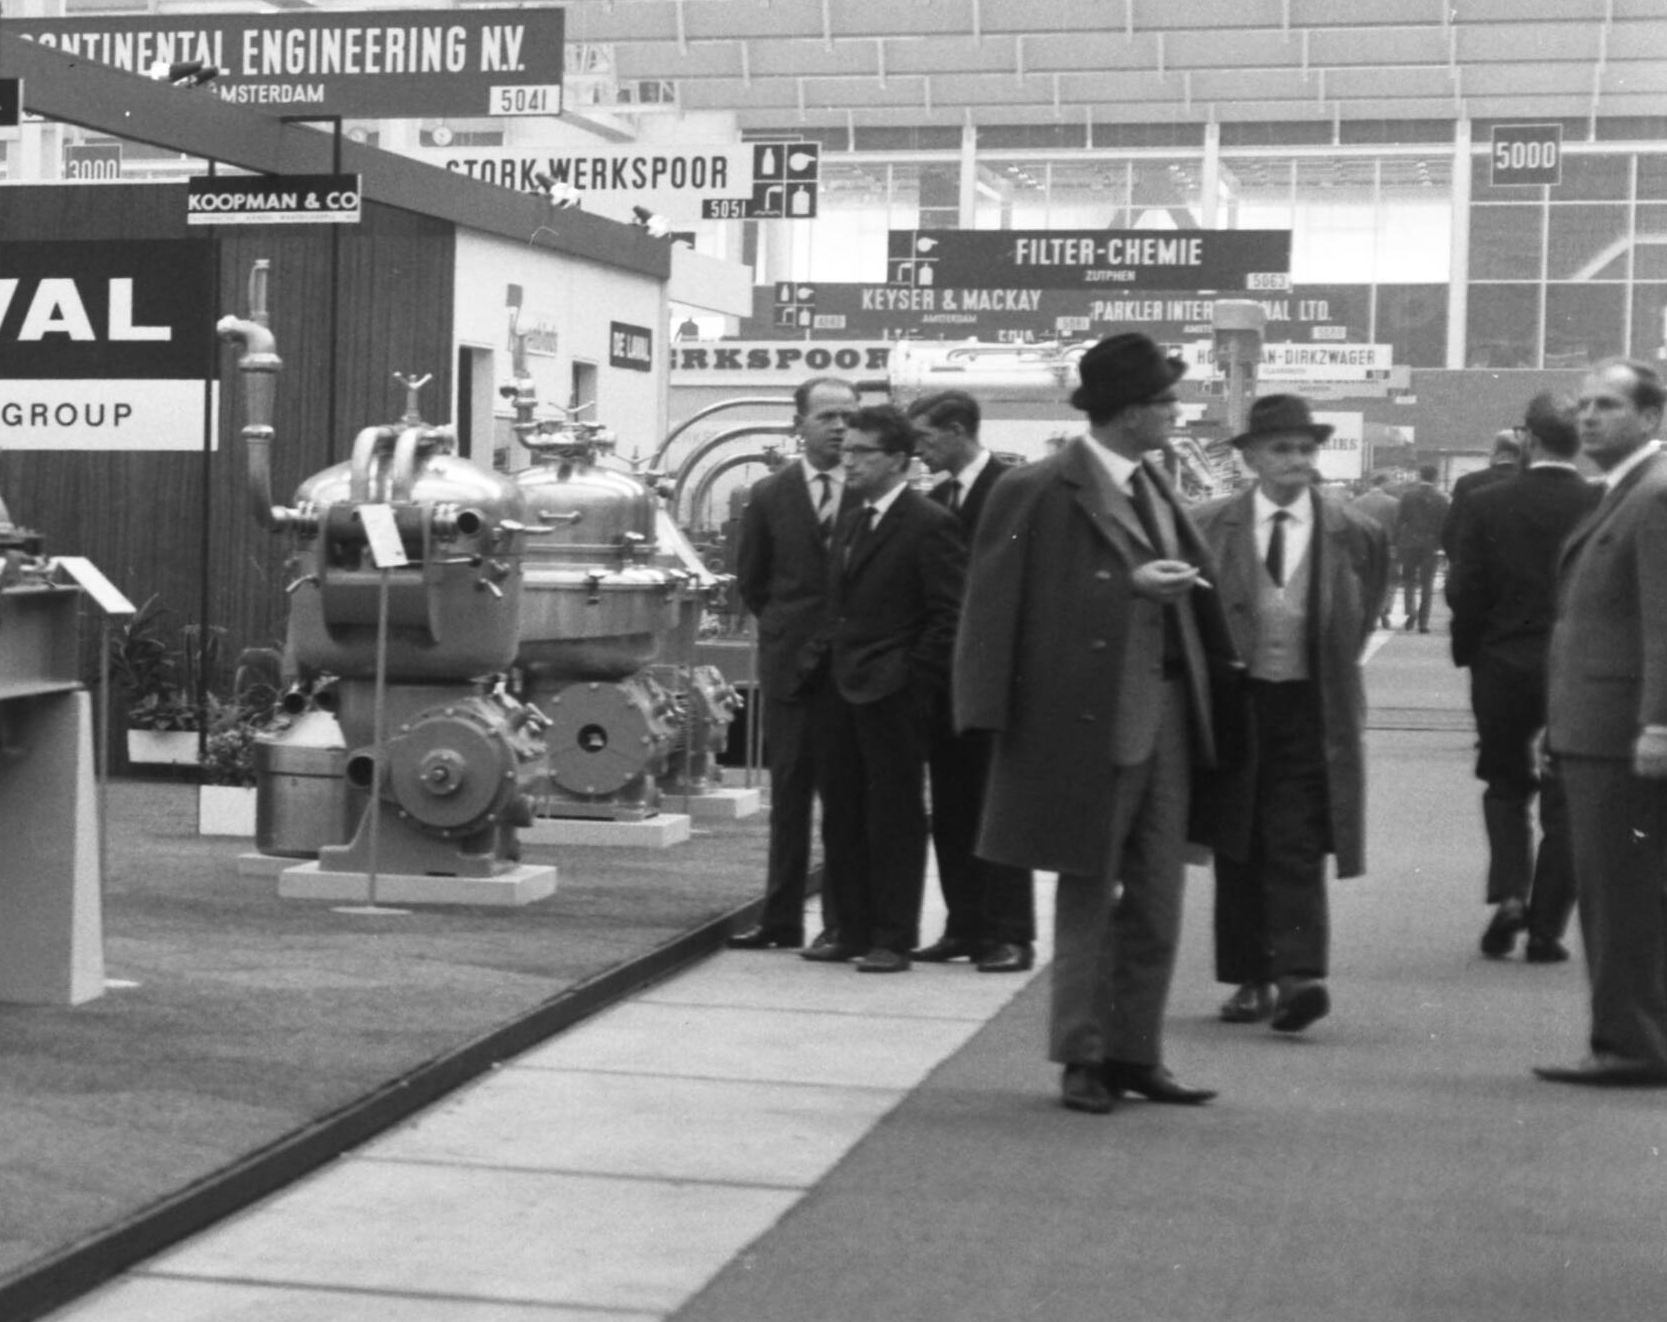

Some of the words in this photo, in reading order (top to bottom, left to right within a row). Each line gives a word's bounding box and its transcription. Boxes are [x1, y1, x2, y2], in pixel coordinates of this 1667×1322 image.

[242, 25, 467, 76] ENGINEERING
[480, 25, 526, 73] N.V.
[212, 82, 325, 105] MSTERDAM
[500, 89, 548, 113] 5041
[1495, 140, 1557, 171] 5000
[548, 155, 728, 191] WERKSPOOR
[188, 192, 298, 211] KOOPMAN
[304, 192, 321, 210] &
[326, 191, 359, 210] CO
[710, 199, 747, 218] 5051
[1015, 237, 1203, 267] FILTER-CHEMIE
[1084, 269, 1136, 282] ZUTPHEN
[861, 289, 935, 311] KEYSER
[941, 289, 957, 311] &
[961, 288, 1043, 311] MACKAY
[0, 402, 133, 428] GROUP
